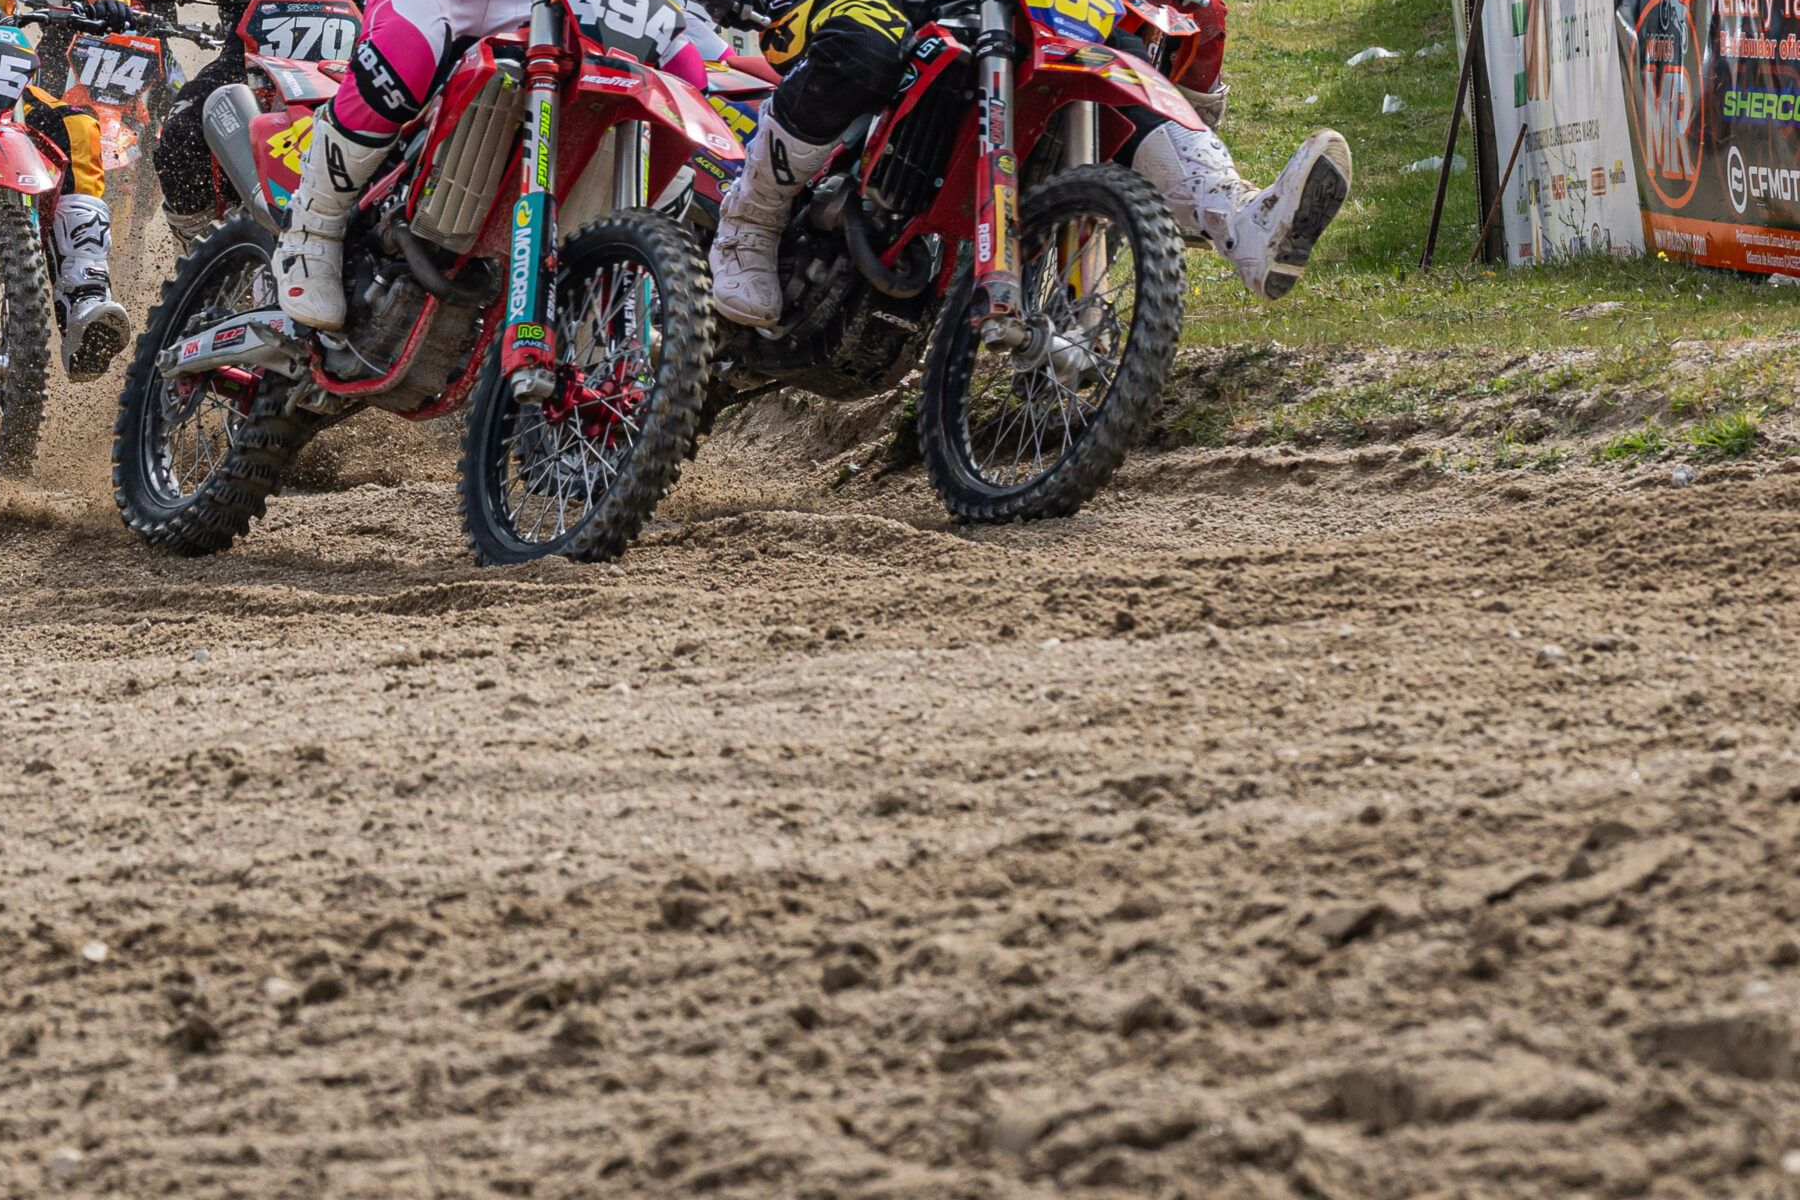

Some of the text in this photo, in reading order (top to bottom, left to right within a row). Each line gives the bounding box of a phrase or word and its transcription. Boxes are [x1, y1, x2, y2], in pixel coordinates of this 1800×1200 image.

[260, 16, 356, 62] 370
[80, 46, 149, 95] 114
[539, 100, 552, 143] ERIC
[1645, 65, 1697, 180] MR
[978, 222, 990, 263] REDD
[511, 227, 531, 320] MOTOREX
[511, 340, 551, 353] BRAKES
